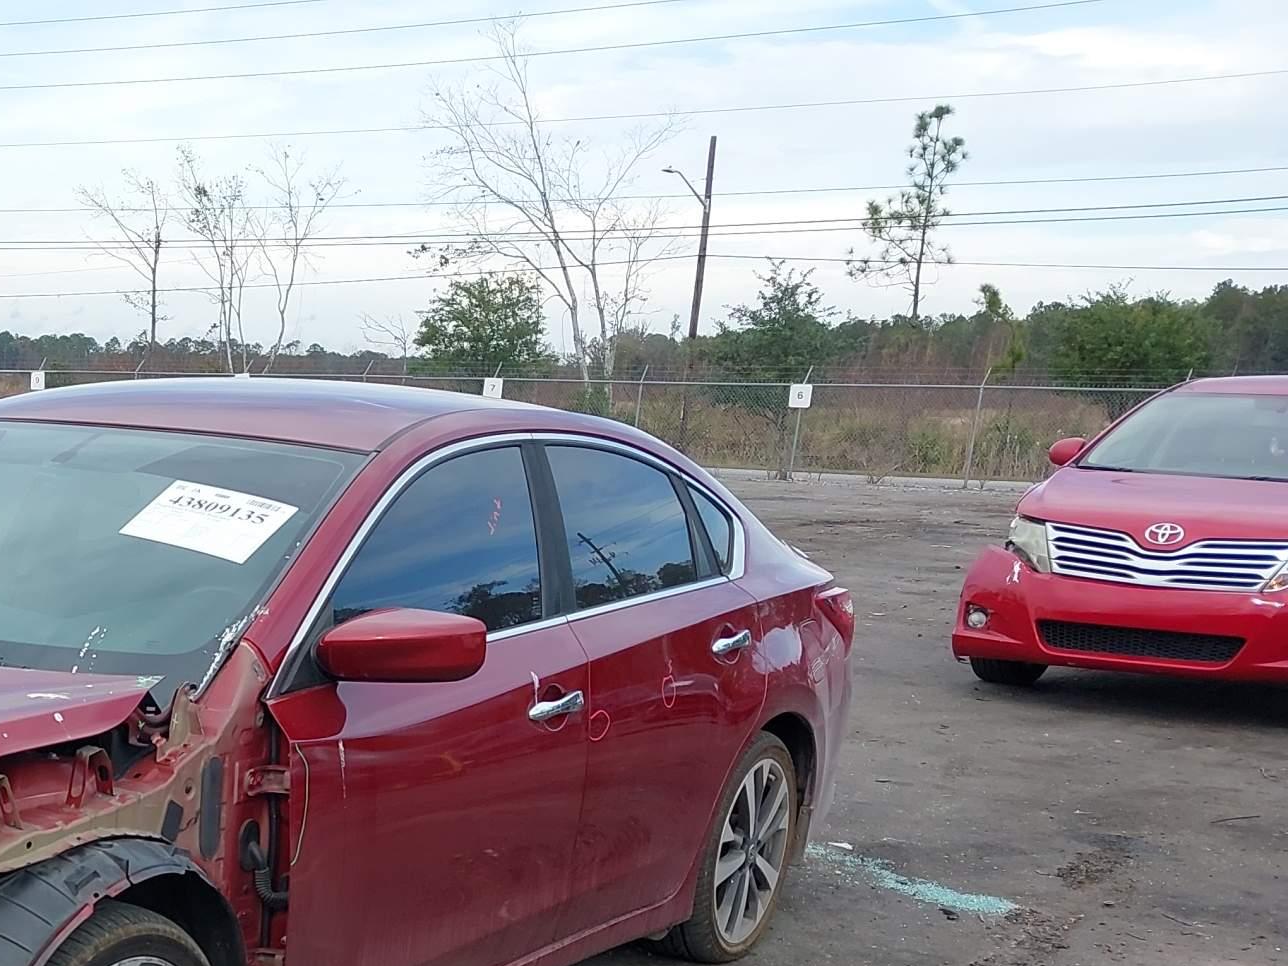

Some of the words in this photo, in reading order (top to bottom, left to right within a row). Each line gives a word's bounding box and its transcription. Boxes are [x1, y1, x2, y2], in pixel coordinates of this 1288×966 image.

[488, 383, 496, 392] 7
[797, 391, 804, 400] 6
[169, 495, 270, 524] 43809135
